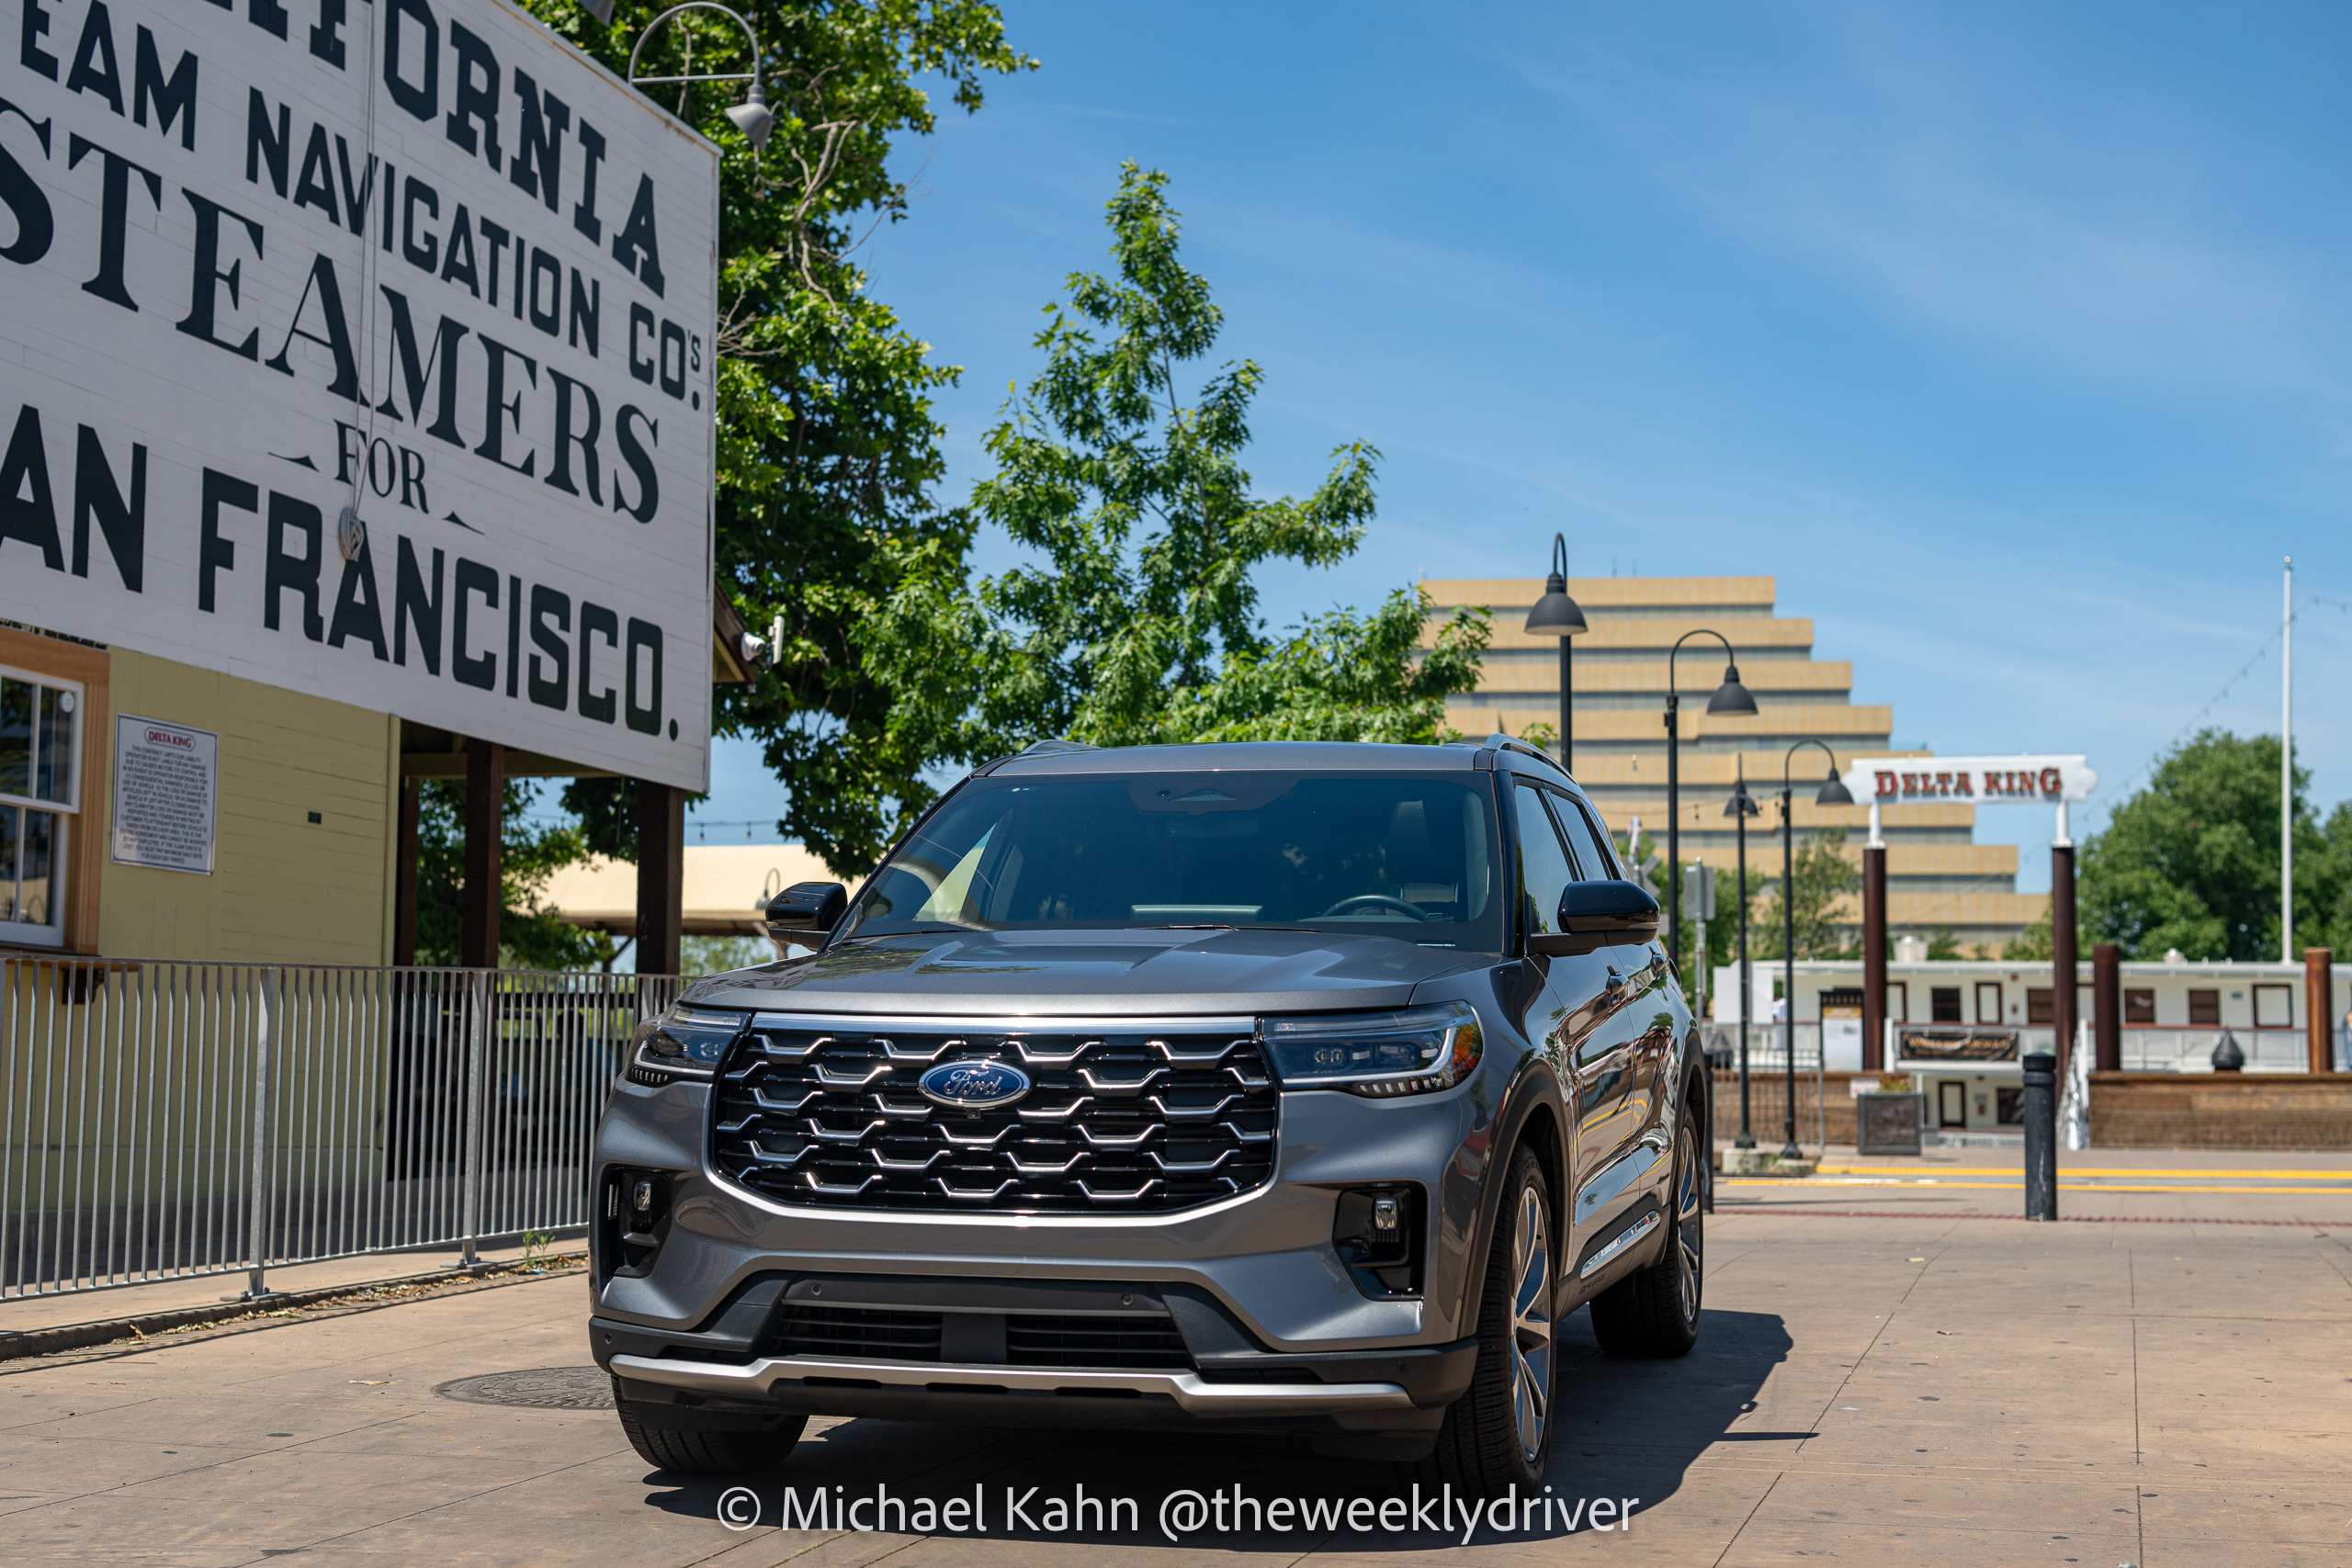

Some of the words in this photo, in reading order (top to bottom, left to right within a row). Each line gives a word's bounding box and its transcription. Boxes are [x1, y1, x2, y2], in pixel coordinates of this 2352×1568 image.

[246, 86, 600, 359] NAVIGATION
[0, 96, 659, 525] STEAMERS
[334, 419, 429, 514] FOR
[198, 467, 679, 742] FRANCISCO.
[148, 731, 171, 744] DELTA
[173, 737, 191, 748] KING
[1874, 770, 1973, 796] DELTA
[1984, 768, 2061, 795] KING
[944, 1069, 1002, 1095] Ford
